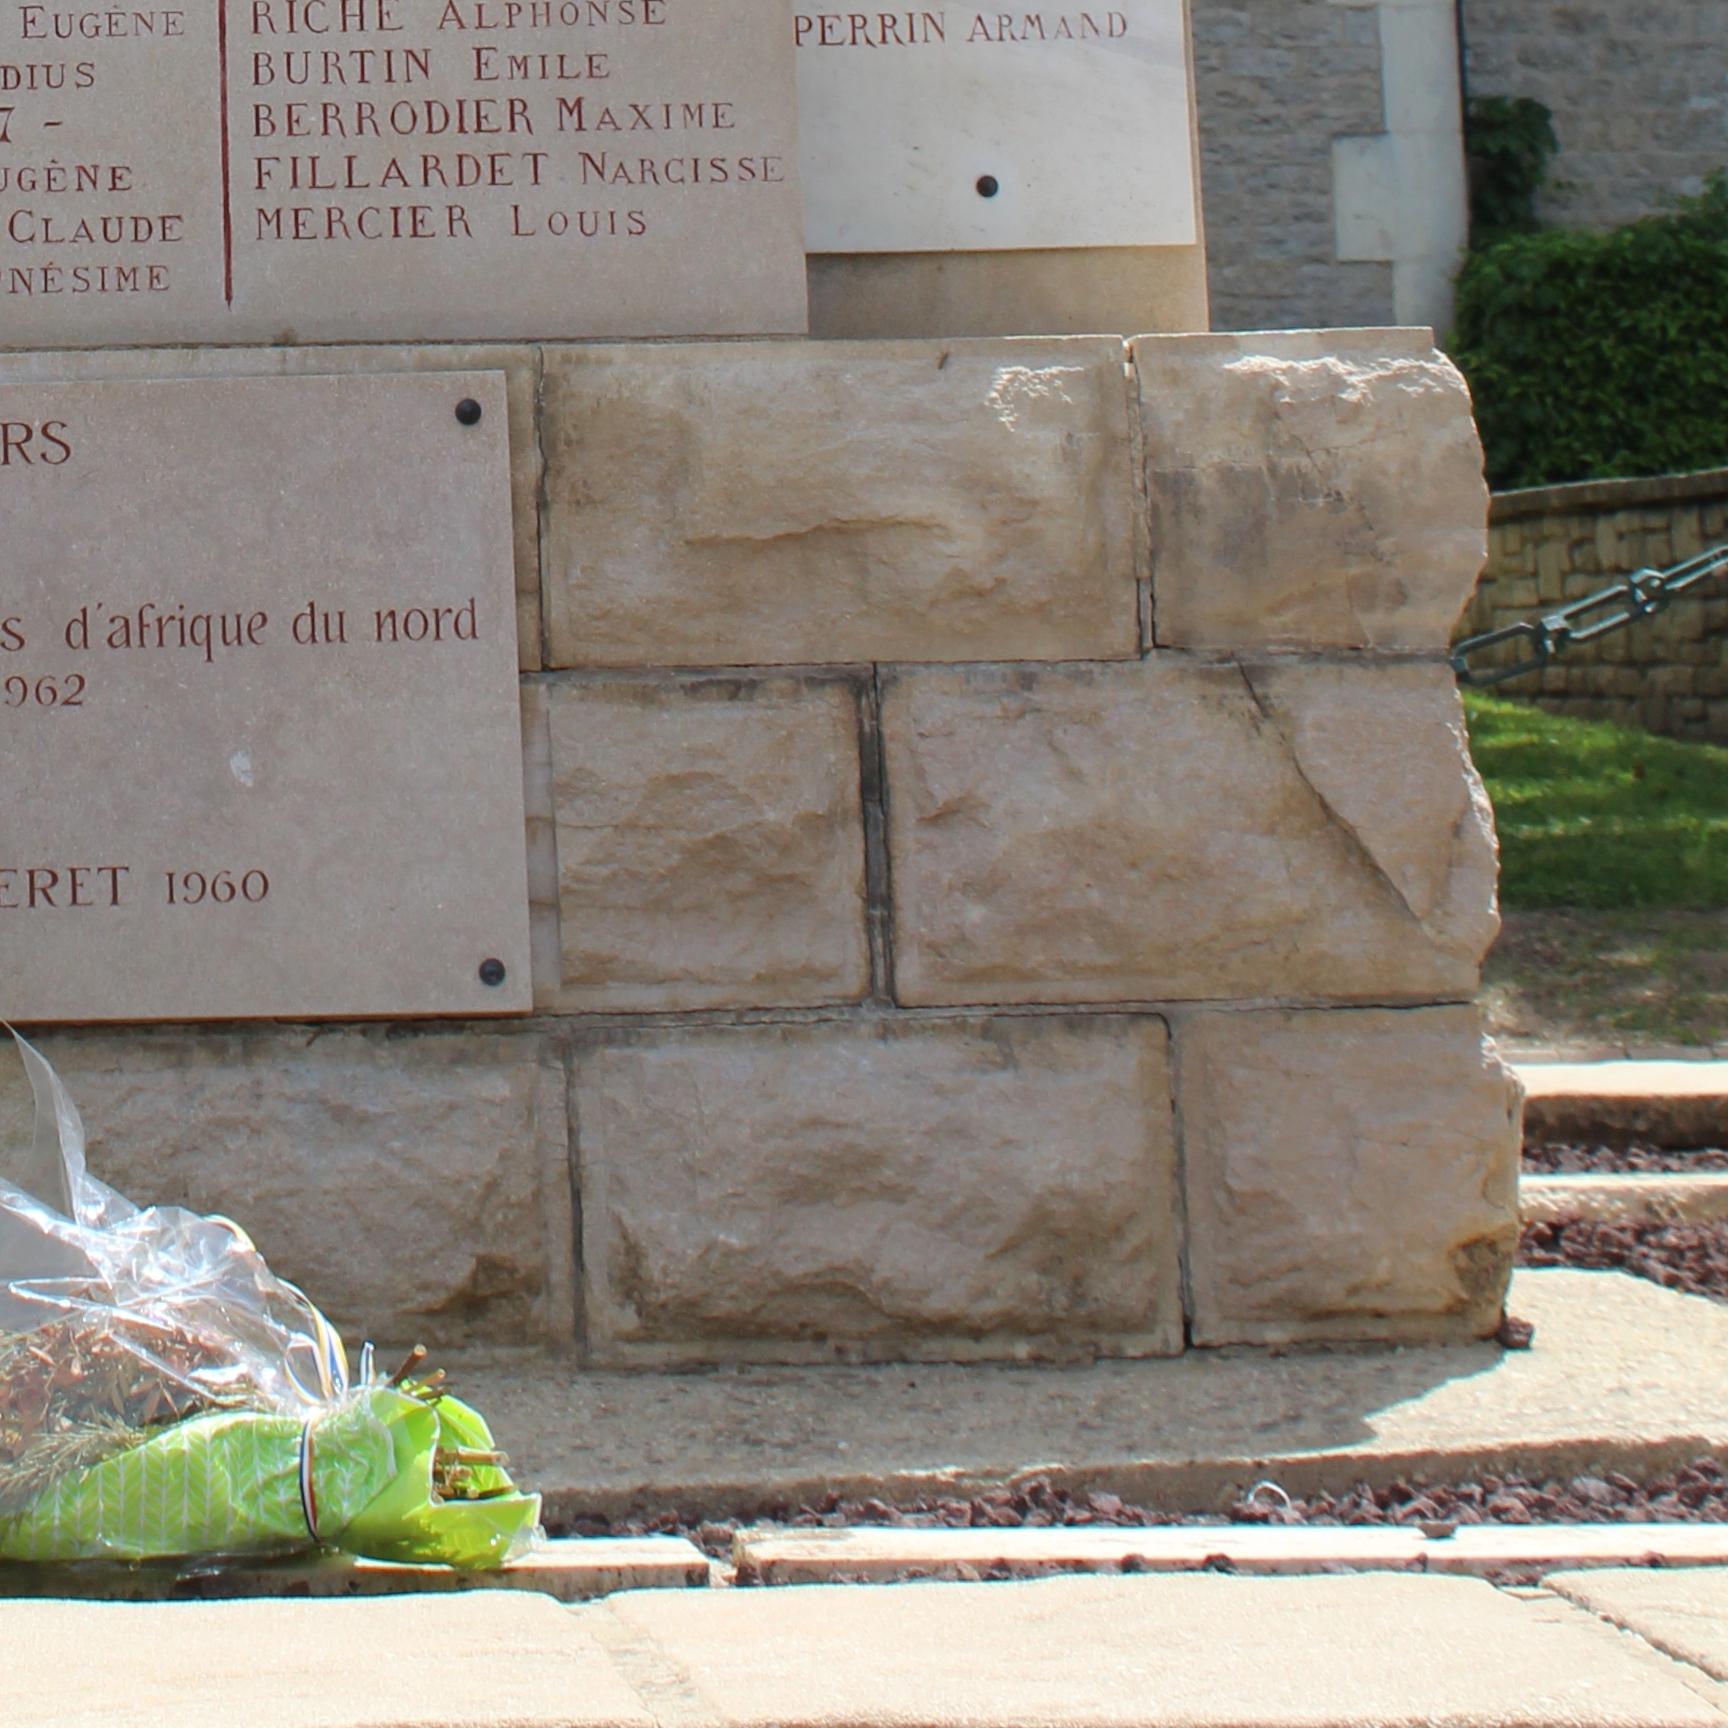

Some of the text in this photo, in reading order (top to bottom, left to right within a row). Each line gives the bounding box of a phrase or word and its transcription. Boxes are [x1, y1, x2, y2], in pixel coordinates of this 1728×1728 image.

[795, 13, 944, 48] PERRIN
[253, 49, 430, 85] BURTIN
[254, 98, 533, 137] BERRODIER
[255, 153, 547, 190] FILLARDET
[257, 205, 471, 240] MERCIER
[292, 601, 346, 644] du
[375, 598, 478, 642] nord
[166, 870, 269, 904] 1960
